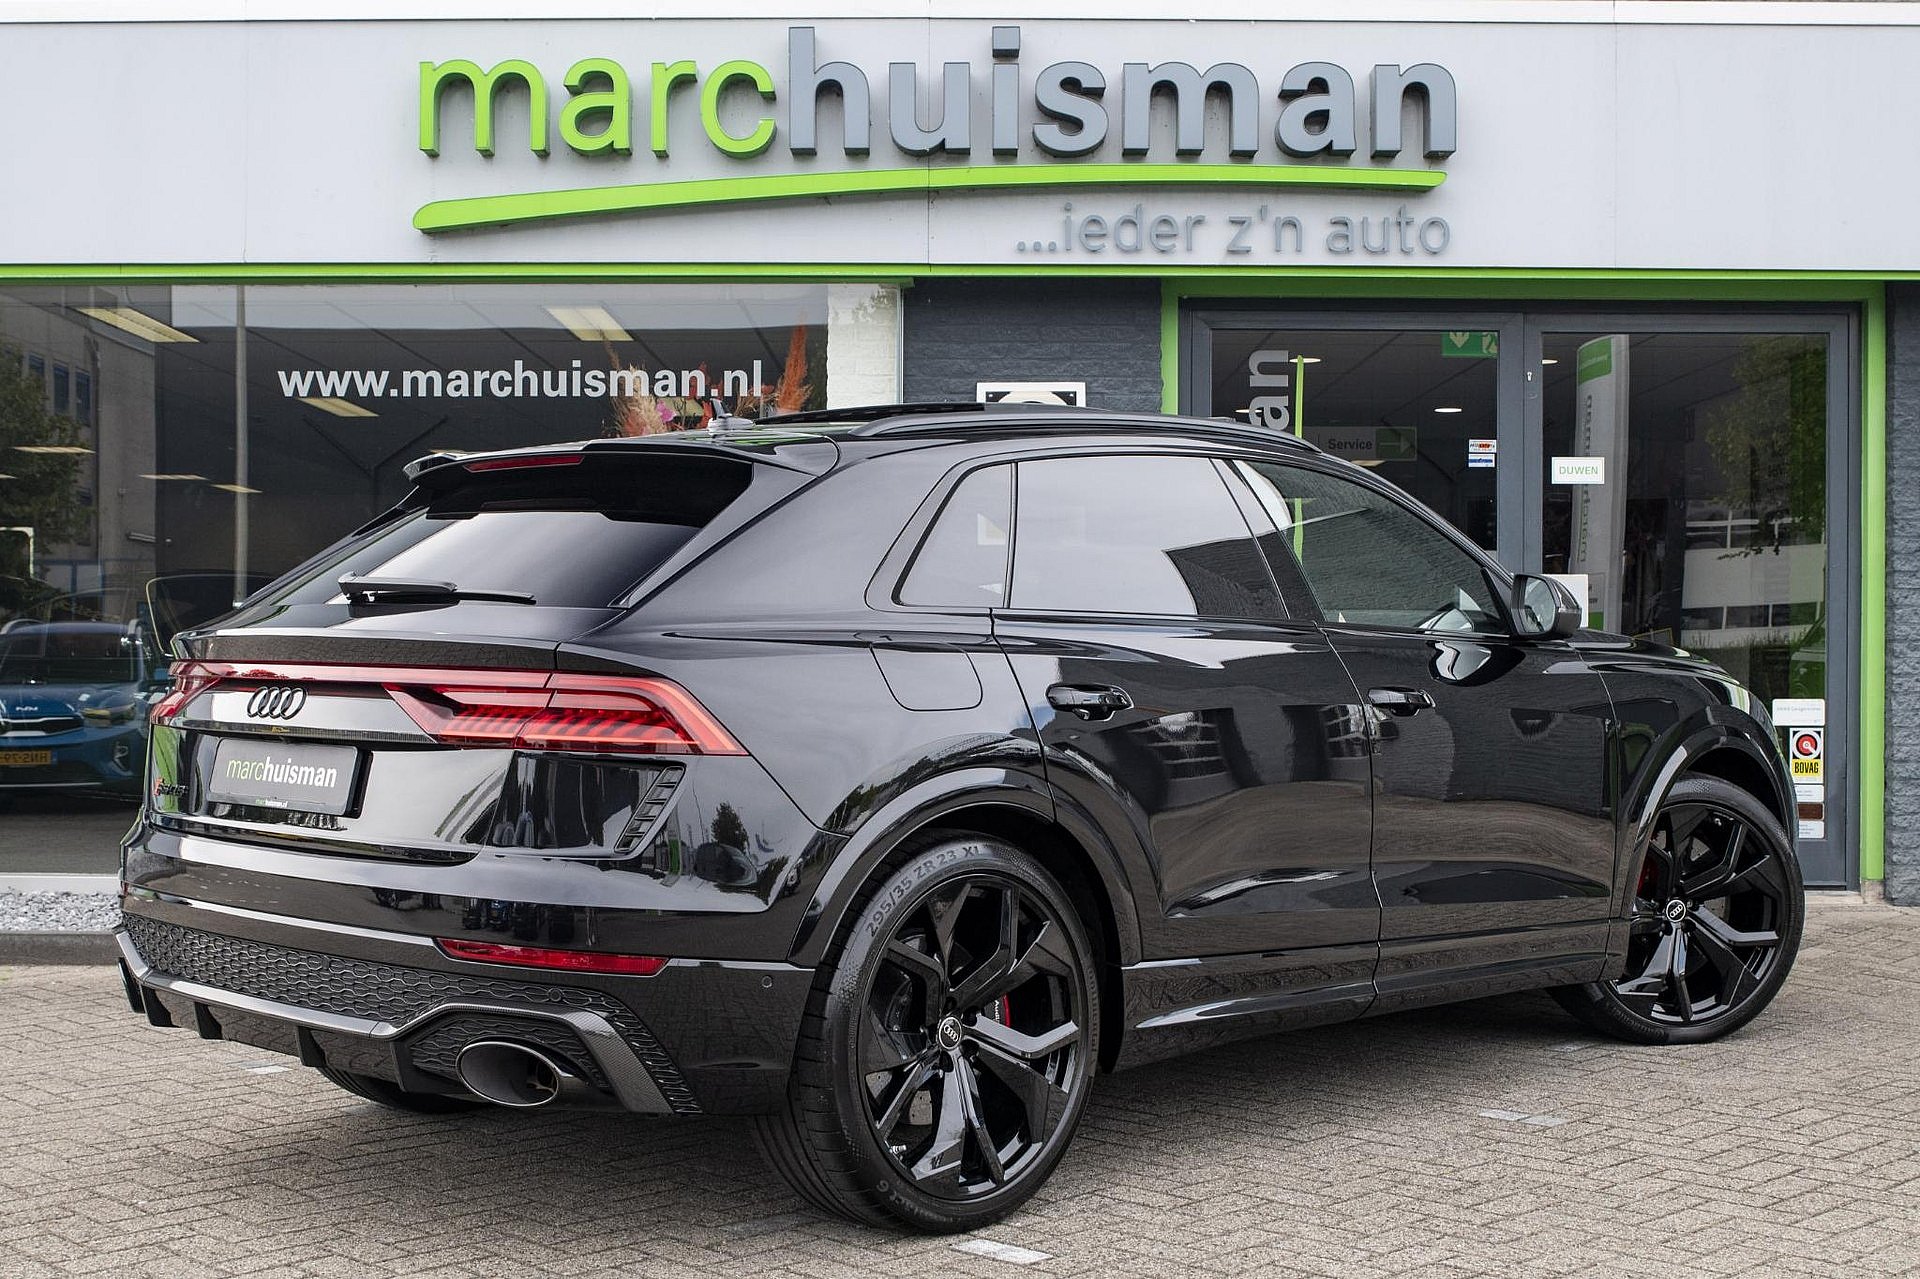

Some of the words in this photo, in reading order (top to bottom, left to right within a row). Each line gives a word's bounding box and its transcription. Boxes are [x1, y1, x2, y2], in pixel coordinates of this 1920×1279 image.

[418, 26, 1458, 159] marchuisman
[1225, 204, 1304, 255] z'n
[1326, 203, 1451, 255] auto
[277, 359, 762, 398] www.marchuisman.nl
[1327, 438, 1373, 450] Service
[1558, 465, 1599, 475] DUWEN
[225, 756, 338, 788] marchuisman
[1794, 761, 1819, 774] BOVAG
[865, 880, 913, 938] 295/35
[913, 859, 937, 878] ZR
[936, 849, 957, 866] 23
